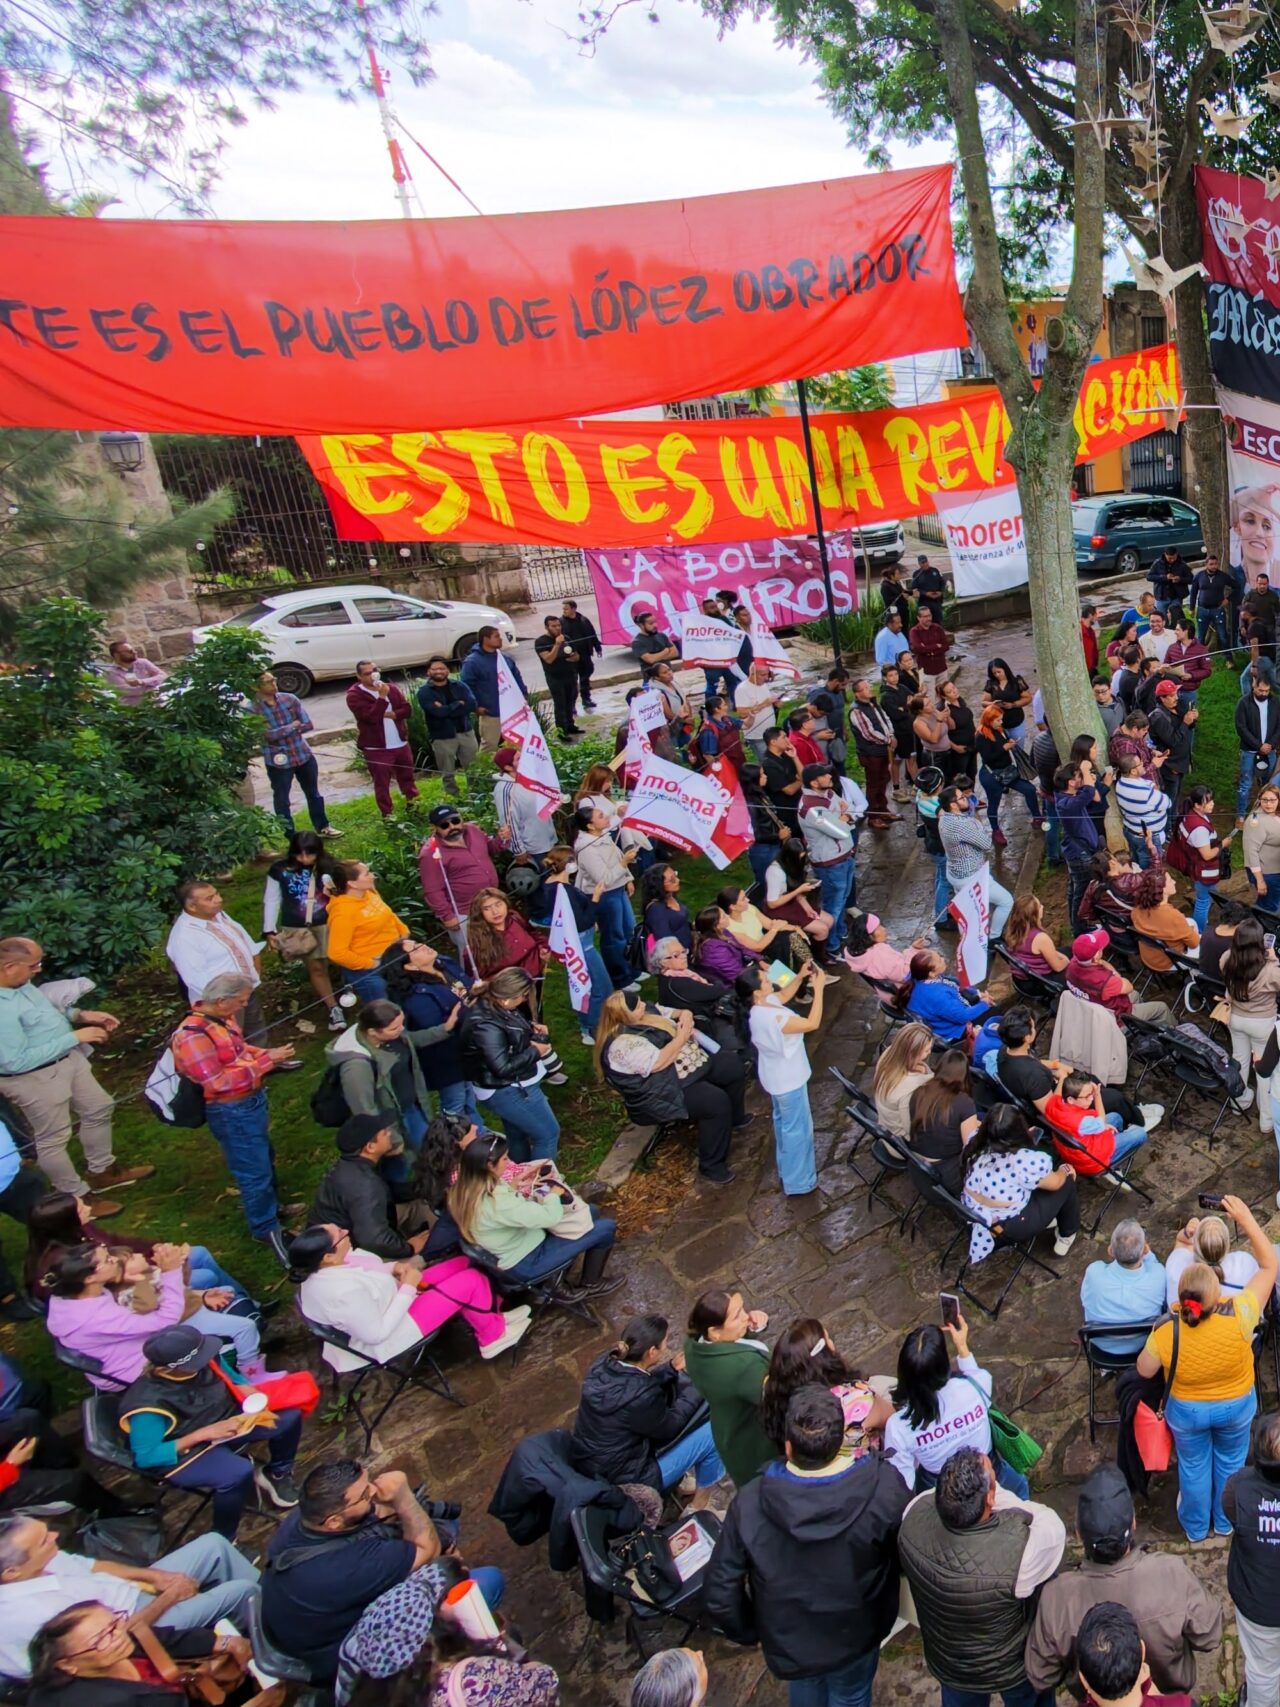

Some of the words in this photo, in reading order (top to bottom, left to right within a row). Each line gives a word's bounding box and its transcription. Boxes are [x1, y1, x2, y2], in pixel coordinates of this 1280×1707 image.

[89, 302, 173, 362] ES
[178, 307, 266, 359] EL
[263, 299, 480, 361] PUEBLO
[488, 296, 557, 347] DE
[570, 269, 725, 340] LÓPEZ
[732, 233, 931, 314] OBRADOR
[321, 429, 590, 535] ESTO
[600, 432, 714, 539] ES
[718, 424, 885, 530] UNA
[883, 346, 1180, 507] REVCIÓN
[599, 550, 662, 589] LA
[680, 538, 800, 584] BOLA
[915, 1403, 985, 1447] morena
